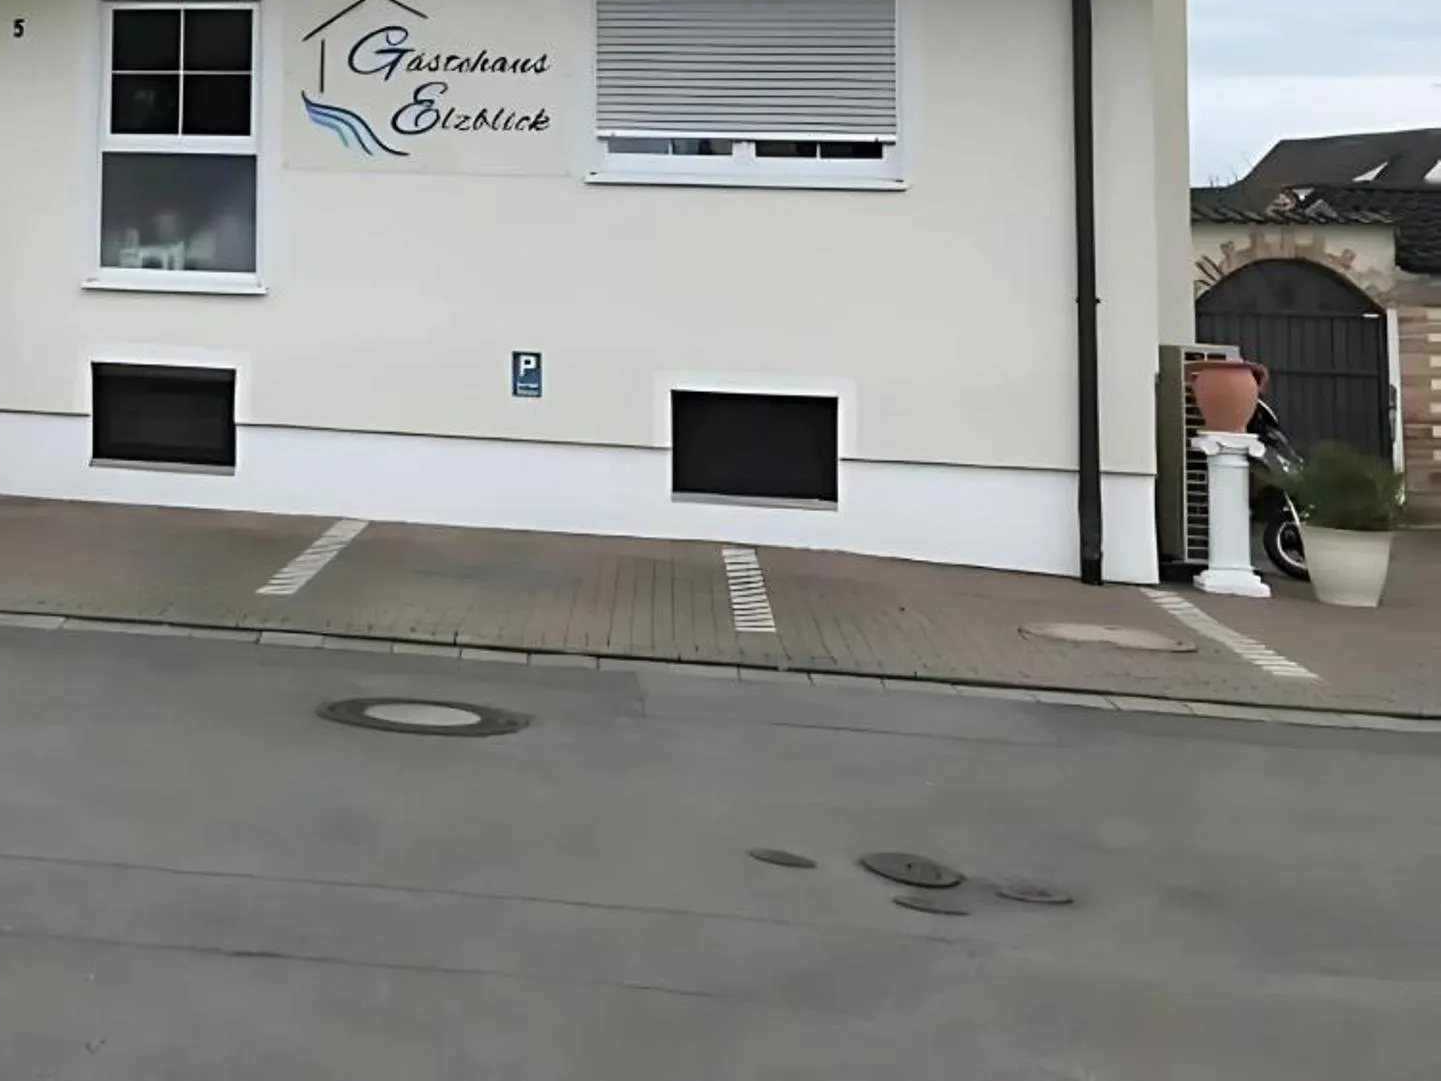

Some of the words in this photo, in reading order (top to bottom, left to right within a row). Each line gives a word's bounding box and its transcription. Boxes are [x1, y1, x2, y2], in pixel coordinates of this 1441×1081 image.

[13, 18, 26, 39] 5
[391, 82, 550, 134] Elzblick
[520, 355, 537, 377] P
